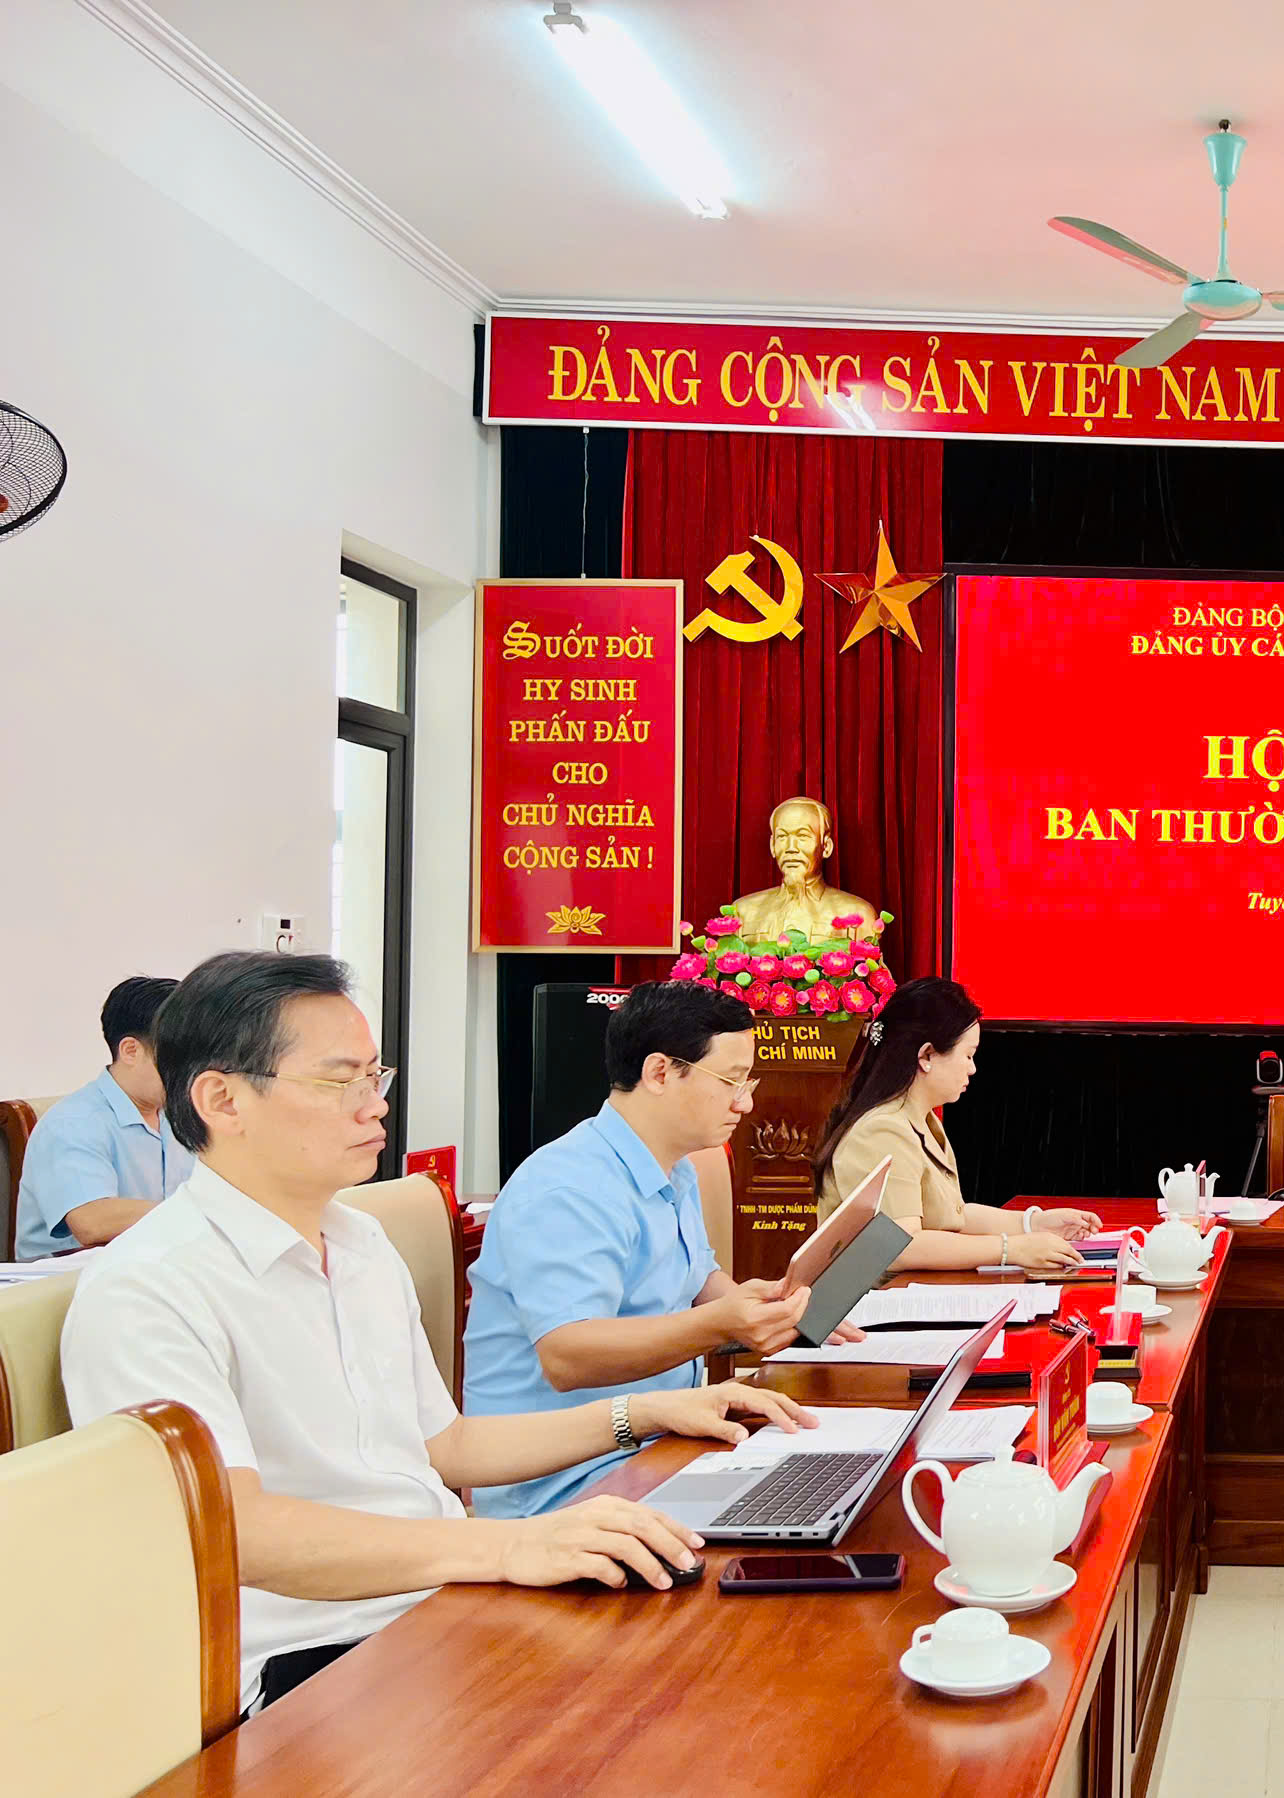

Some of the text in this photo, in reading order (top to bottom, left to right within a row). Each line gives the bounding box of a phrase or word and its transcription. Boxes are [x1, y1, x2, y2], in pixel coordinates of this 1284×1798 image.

[549, 327, 700, 405] ĐẢNG
[720, 336, 866, 422] CỘNG
[883, 335, 993, 414] SẢN
[1008, 348, 1140, 431] VIỆT
[1156, 366, 1280, 421] NAM
[1172, 602, 1244, 627] ĐẢNG
[1251, 604, 1284, 629] BỘ
[504, 621, 653, 659] SUỐT ĐỜI
[1131, 631, 1204, 656] ĐẢNG
[1211, 631, 1247, 657] ỦY
[524, 680, 636, 700] HY SINH
[509, 709, 651, 742] PHẤN ĐẤU
[553, 762, 608, 784] CHO
[504, 793, 655, 827] CHỦ NGHĨA
[1045, 808, 1139, 840] BAN
[504, 837, 653, 875] CỘNG SẢN !
[751, 1020, 820, 1044] HỦ TỊCH
[757, 1042, 836, 1060] CHÍ MINH
